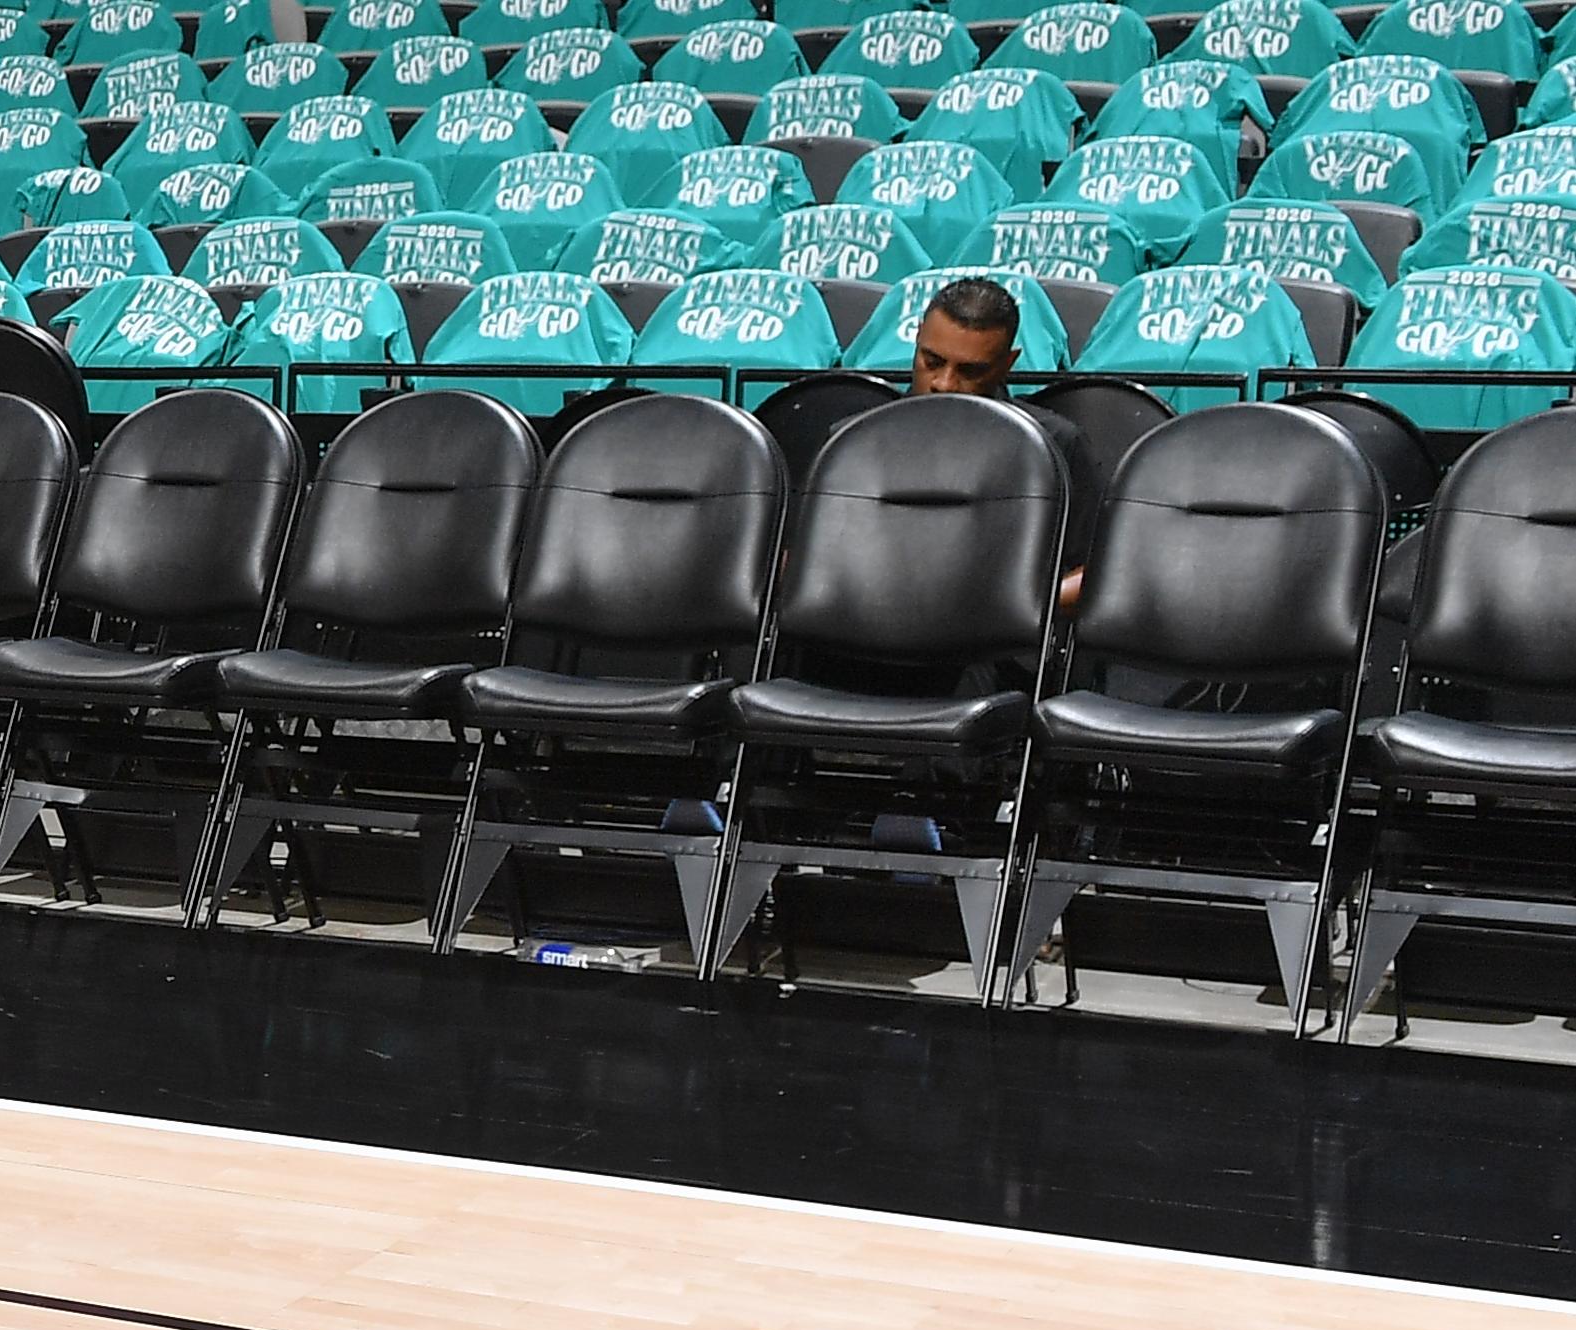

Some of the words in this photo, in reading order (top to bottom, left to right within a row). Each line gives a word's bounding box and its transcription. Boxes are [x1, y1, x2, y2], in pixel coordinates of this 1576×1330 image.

[91, 8, 121, 33] GO
[127, 5, 154, 31] GO
[348, 3, 376, 28] GO
[386, 2, 414, 30] GO
[1408, 4, 1448, 35] GO
[1465, 1, 1504, 34] GO
[687, 31, 720, 61] GO
[731, 32, 765, 61] GO
[862, 33, 897, 65] GO
[909, 34, 943, 65] GO
[1023, 21, 1059, 54] GO
[1074, 21, 1109, 53] GO
[1204, 27, 1245, 58] GO
[1252, 28, 1290, 58] GO
[246, 62, 277, 88] GO
[289, 57, 316, 84] GO
[396, 55, 427, 84] GO
[439, 47, 470, 75] GO
[526, 53, 559, 84] GO
[570, 48, 601, 79] GO
[1328, 55, 1439, 90] FINALS
[29, 70, 55, 97] GO
[106, 61, 180, 105] FINALS
[938, 84, 975, 114] GO
[987, 81, 1024, 110] GO
[1329, 84, 1369, 112] GO
[1389, 79, 1430, 109] GO
[149, 102, 229, 134] FINALS
[439, 89, 527, 121] FINALS
[611, 103, 646, 130] GO
[658, 102, 693, 130] GO
[768, 87, 863, 126] FINALS
[185, 127, 217, 151] GO
[287, 118, 318, 144] GO
[330, 115, 363, 140] GO
[436, 118, 469, 144] GO
[479, 117, 514, 143] GO
[498, 153, 596, 186] FINALS
[679, 147, 779, 184] FINALS
[871, 143, 973, 181] FINALS
[1080, 140, 1194, 178] FINALS
[70, 167, 102, 195] GO
[200, 177, 231, 210] GO
[354, 183, 388, 196] 2026
[496, 184, 531, 210] GO
[547, 181, 584, 210] GO
[679, 178, 714, 206] GO
[728, 178, 767, 206] GO
[872, 176, 909, 204] GO
[1079, 173, 1119, 203] GO
[1137, 174, 1180, 203] GO
[1494, 168, 1537, 196] GO
[636, 211, 675, 230] 2026
[1030, 210, 1076, 224] 2026
[1264, 207, 1312, 222] 2026
[1510, 202, 1562, 220] 2026
[235, 222, 271, 235] 2026
[417, 224, 457, 239] 2026
[781, 206, 894, 251] FINALS
[990, 222, 1111, 268] FINALS
[1221, 219, 1349, 268] FINALS
[46, 234, 136, 270] FINALS
[206, 232, 302, 275] FINALS
[384, 236, 482, 277] FINALS
[593, 222, 701, 274] FINALS
[837, 245, 879, 279] GO
[480, 272, 594, 314] FINALS
[681, 272, 804, 318] FINALS
[1140, 271, 1268, 315] FINALS
[1447, 271, 1503, 287] 2026
[128, 277, 224, 338] FINALS
[277, 278, 373, 314] FINALS
[1398, 284, 1539, 334] FINALS
[271, 312, 310, 343] GO
[322, 309, 363, 341] GO
[478, 309, 519, 340] GO
[537, 305, 580, 339] GO
[677, 307, 721, 340] GO
[737, 309, 784, 342] GO
[1138, 309, 1185, 343] GO
[154, 327, 197, 357] GO
[1396, 321, 1448, 357] GO
[1472, 324, 1519, 358] GO
[542, 951, 589, 970] smart
